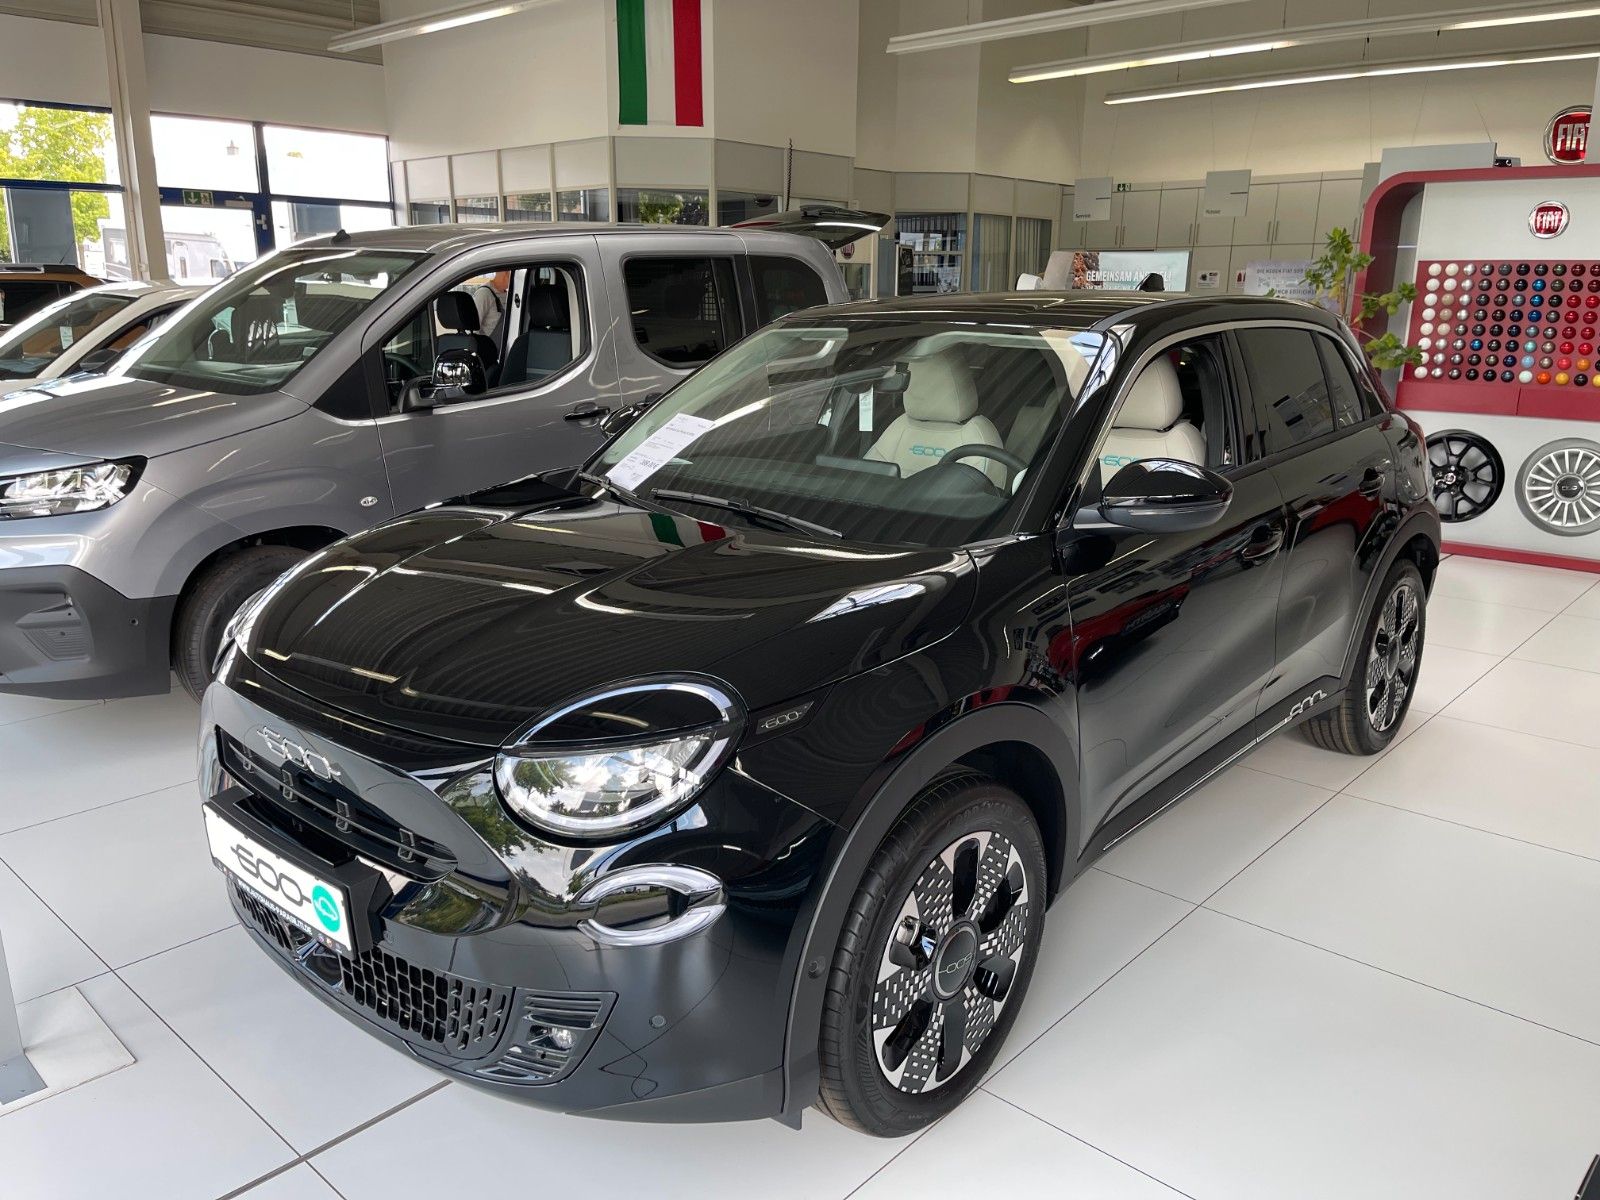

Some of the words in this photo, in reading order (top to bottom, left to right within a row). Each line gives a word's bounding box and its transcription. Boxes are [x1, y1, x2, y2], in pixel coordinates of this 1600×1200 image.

[1556, 123, 1589, 151] FIA
[1536, 210, 1562, 230] FIAT
[1086, 271, 1132, 282] GEMEINSAM
[763, 710, 800, 729] 600
[257, 725, 340, 782] 600
[230, 843, 311, 907] 600
